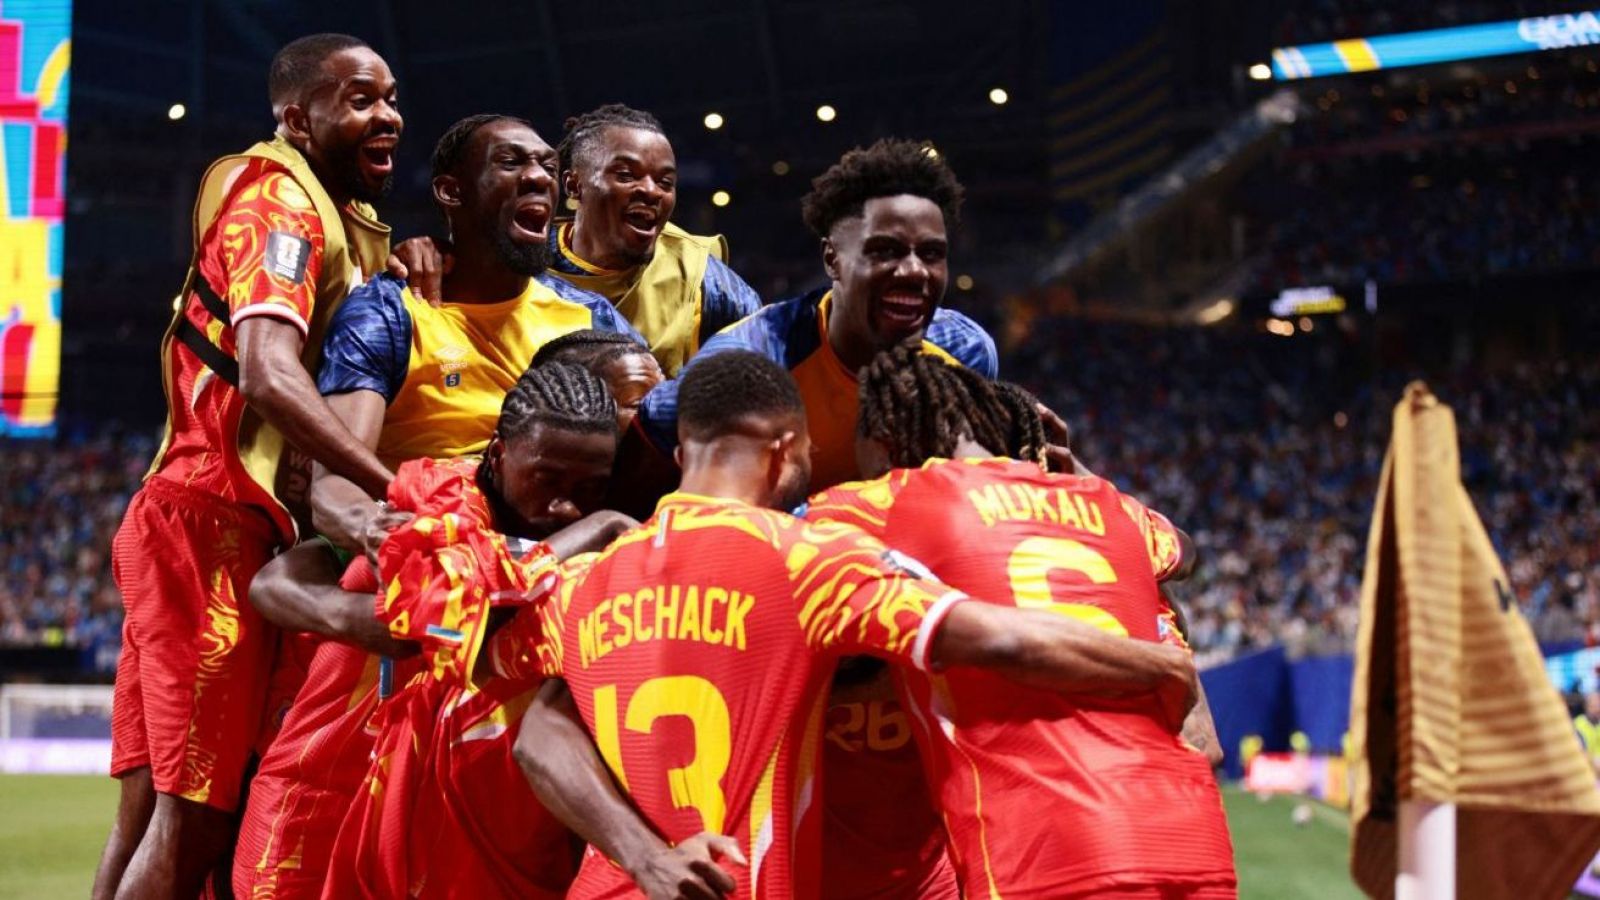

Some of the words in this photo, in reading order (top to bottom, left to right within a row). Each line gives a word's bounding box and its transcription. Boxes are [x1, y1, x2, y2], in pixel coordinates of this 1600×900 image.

[968, 483, 1106, 536] MUKAU
[578, 585, 755, 670] MESCHACK
[593, 674, 732, 836] 13
[825, 701, 911, 752] 26
